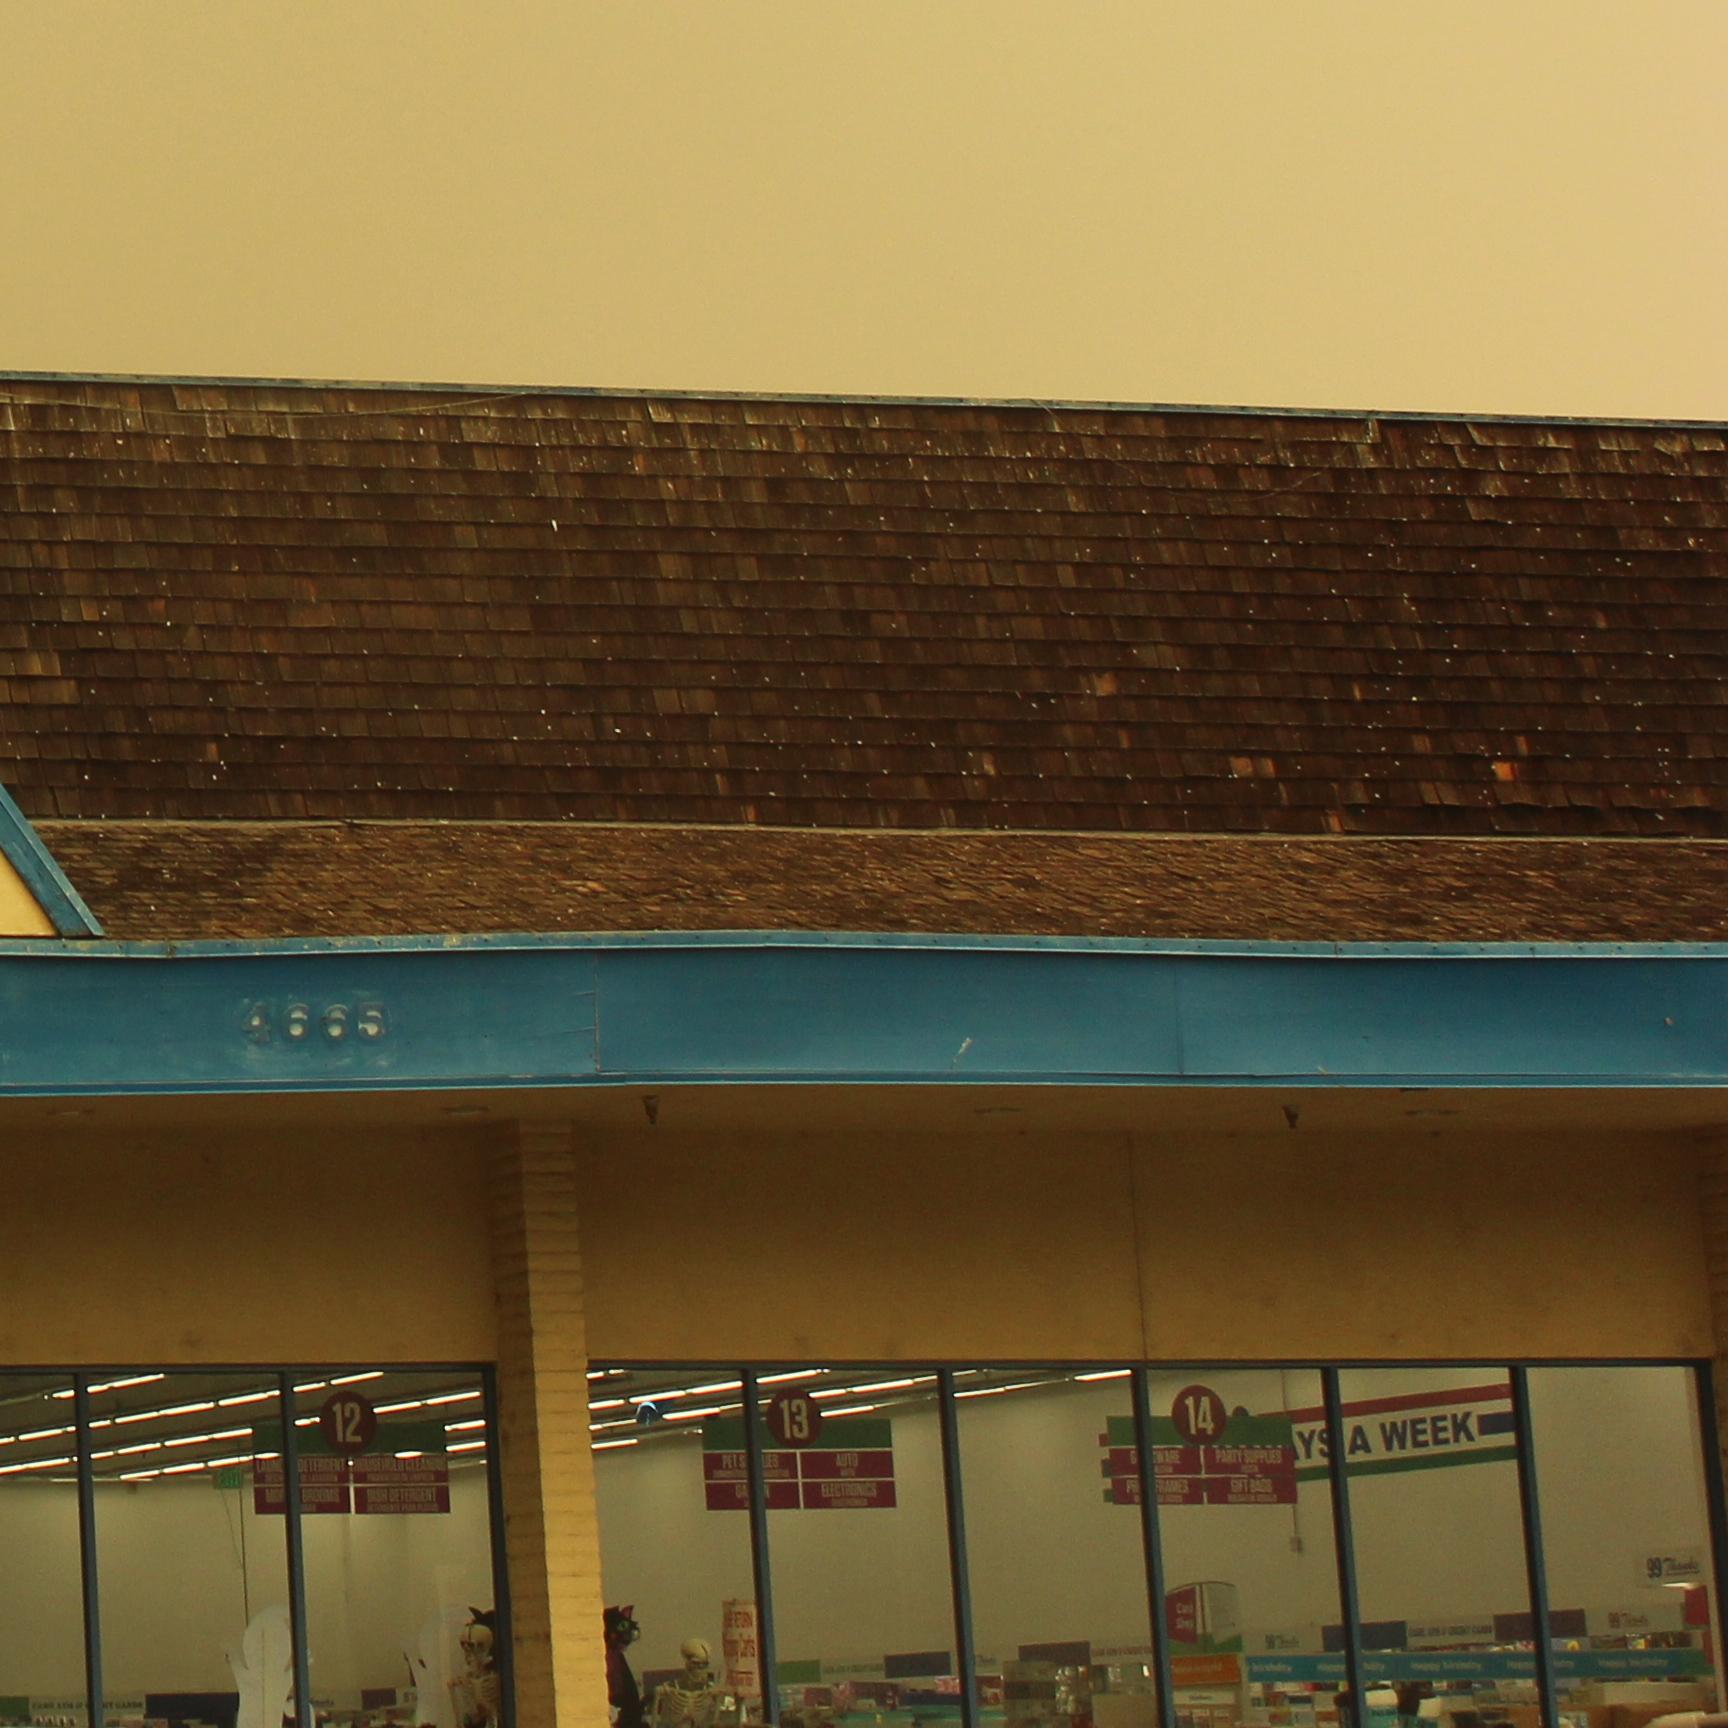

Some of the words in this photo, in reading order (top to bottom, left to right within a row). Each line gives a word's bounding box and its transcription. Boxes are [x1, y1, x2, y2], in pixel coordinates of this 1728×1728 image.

[332, 1401, 363, 1442] 12
[780, 1392, 810, 1440] 13
[1184, 1396, 1214, 1435] 14
[1348, 1425, 1372, 1455] A
[1379, 1411, 1475, 1452] WEEK
[721, 1454, 737, 1469] PET
[739, 1454, 779, 1469] SLIES
[836, 1453, 858, 1467] AUTO
[1216, 1450, 1241, 1463] PARTY
[1243, 1450, 1282, 1463] SUPPLIES
[821, 1483, 877, 1497] ELECTRONICS
[1231, 1479, 1249, 1493] GIFT
[1251, 1479, 1272, 1493] BAGS
